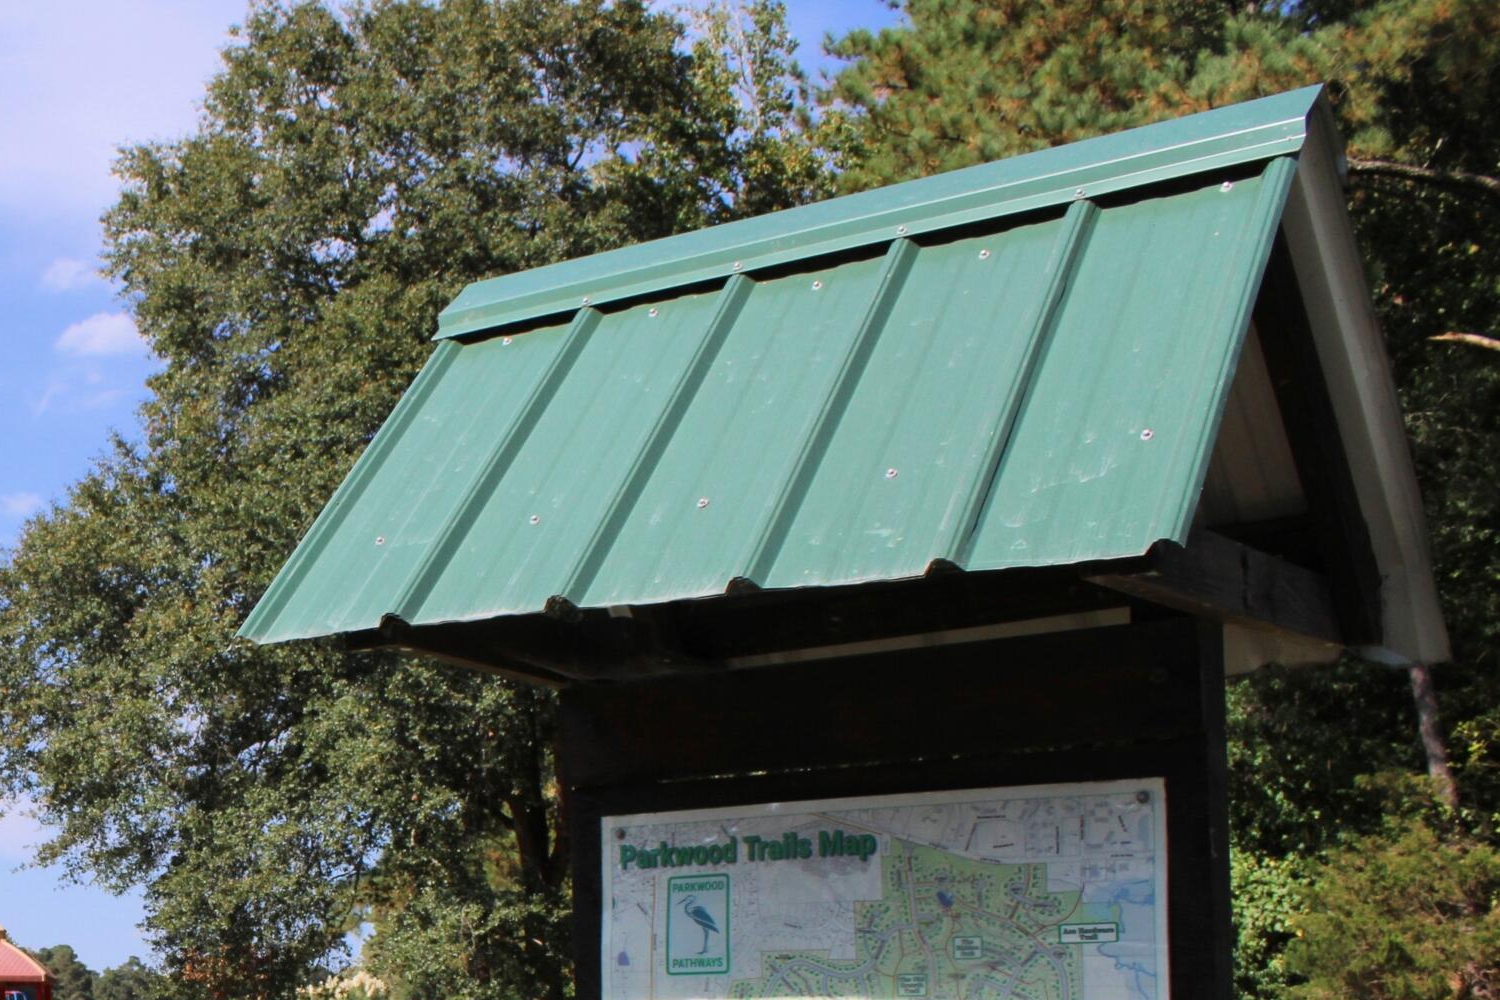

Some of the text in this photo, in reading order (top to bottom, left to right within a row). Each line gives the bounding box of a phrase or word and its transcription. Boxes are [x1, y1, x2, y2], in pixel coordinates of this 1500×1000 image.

[620, 829, 877, 870] Parkwood Trails Map
[672, 880, 725, 893] PARKWOOD
[672, 956, 724, 969] PATHWAYS
